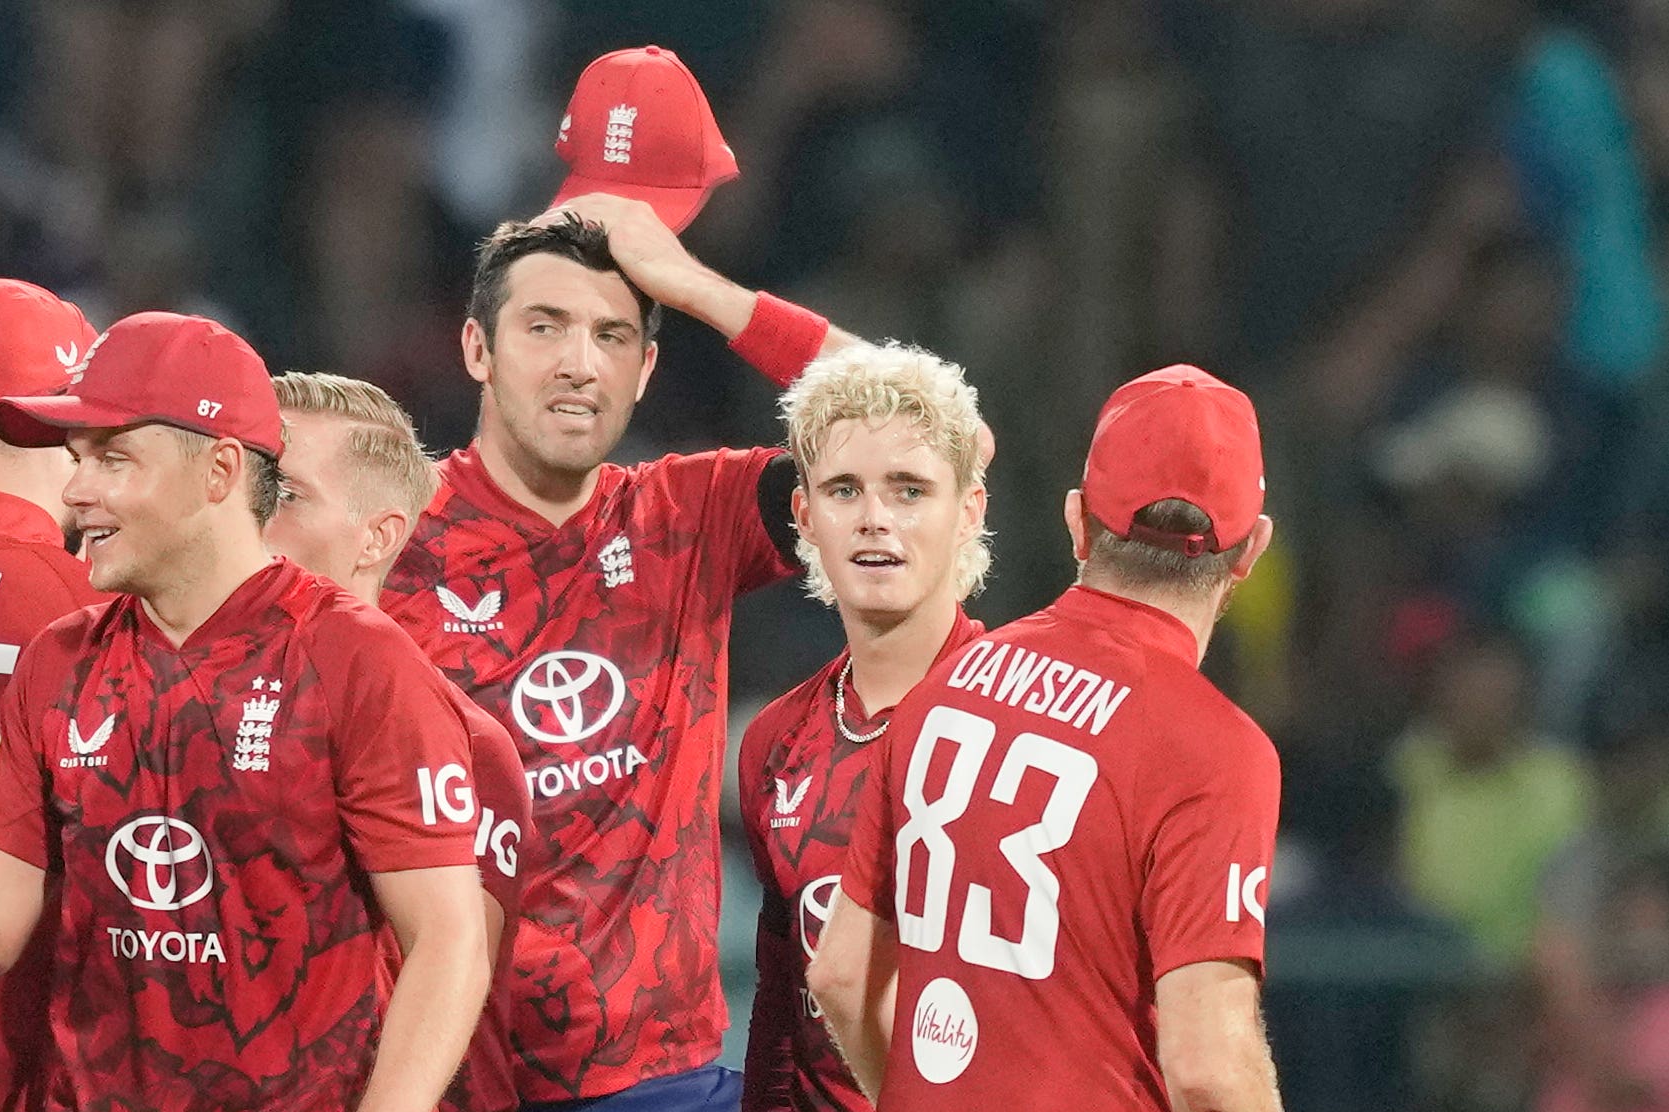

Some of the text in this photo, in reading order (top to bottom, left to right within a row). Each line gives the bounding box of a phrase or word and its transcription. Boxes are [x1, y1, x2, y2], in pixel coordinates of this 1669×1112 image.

[197, 399, 223, 419] 87
[947, 640, 1131, 736] DAWSON
[417, 763, 475, 825] IG
[895, 704, 1099, 980] 83
[106, 926, 226, 964] TOYOTA
[916, 1001, 974, 1062] Vitality
